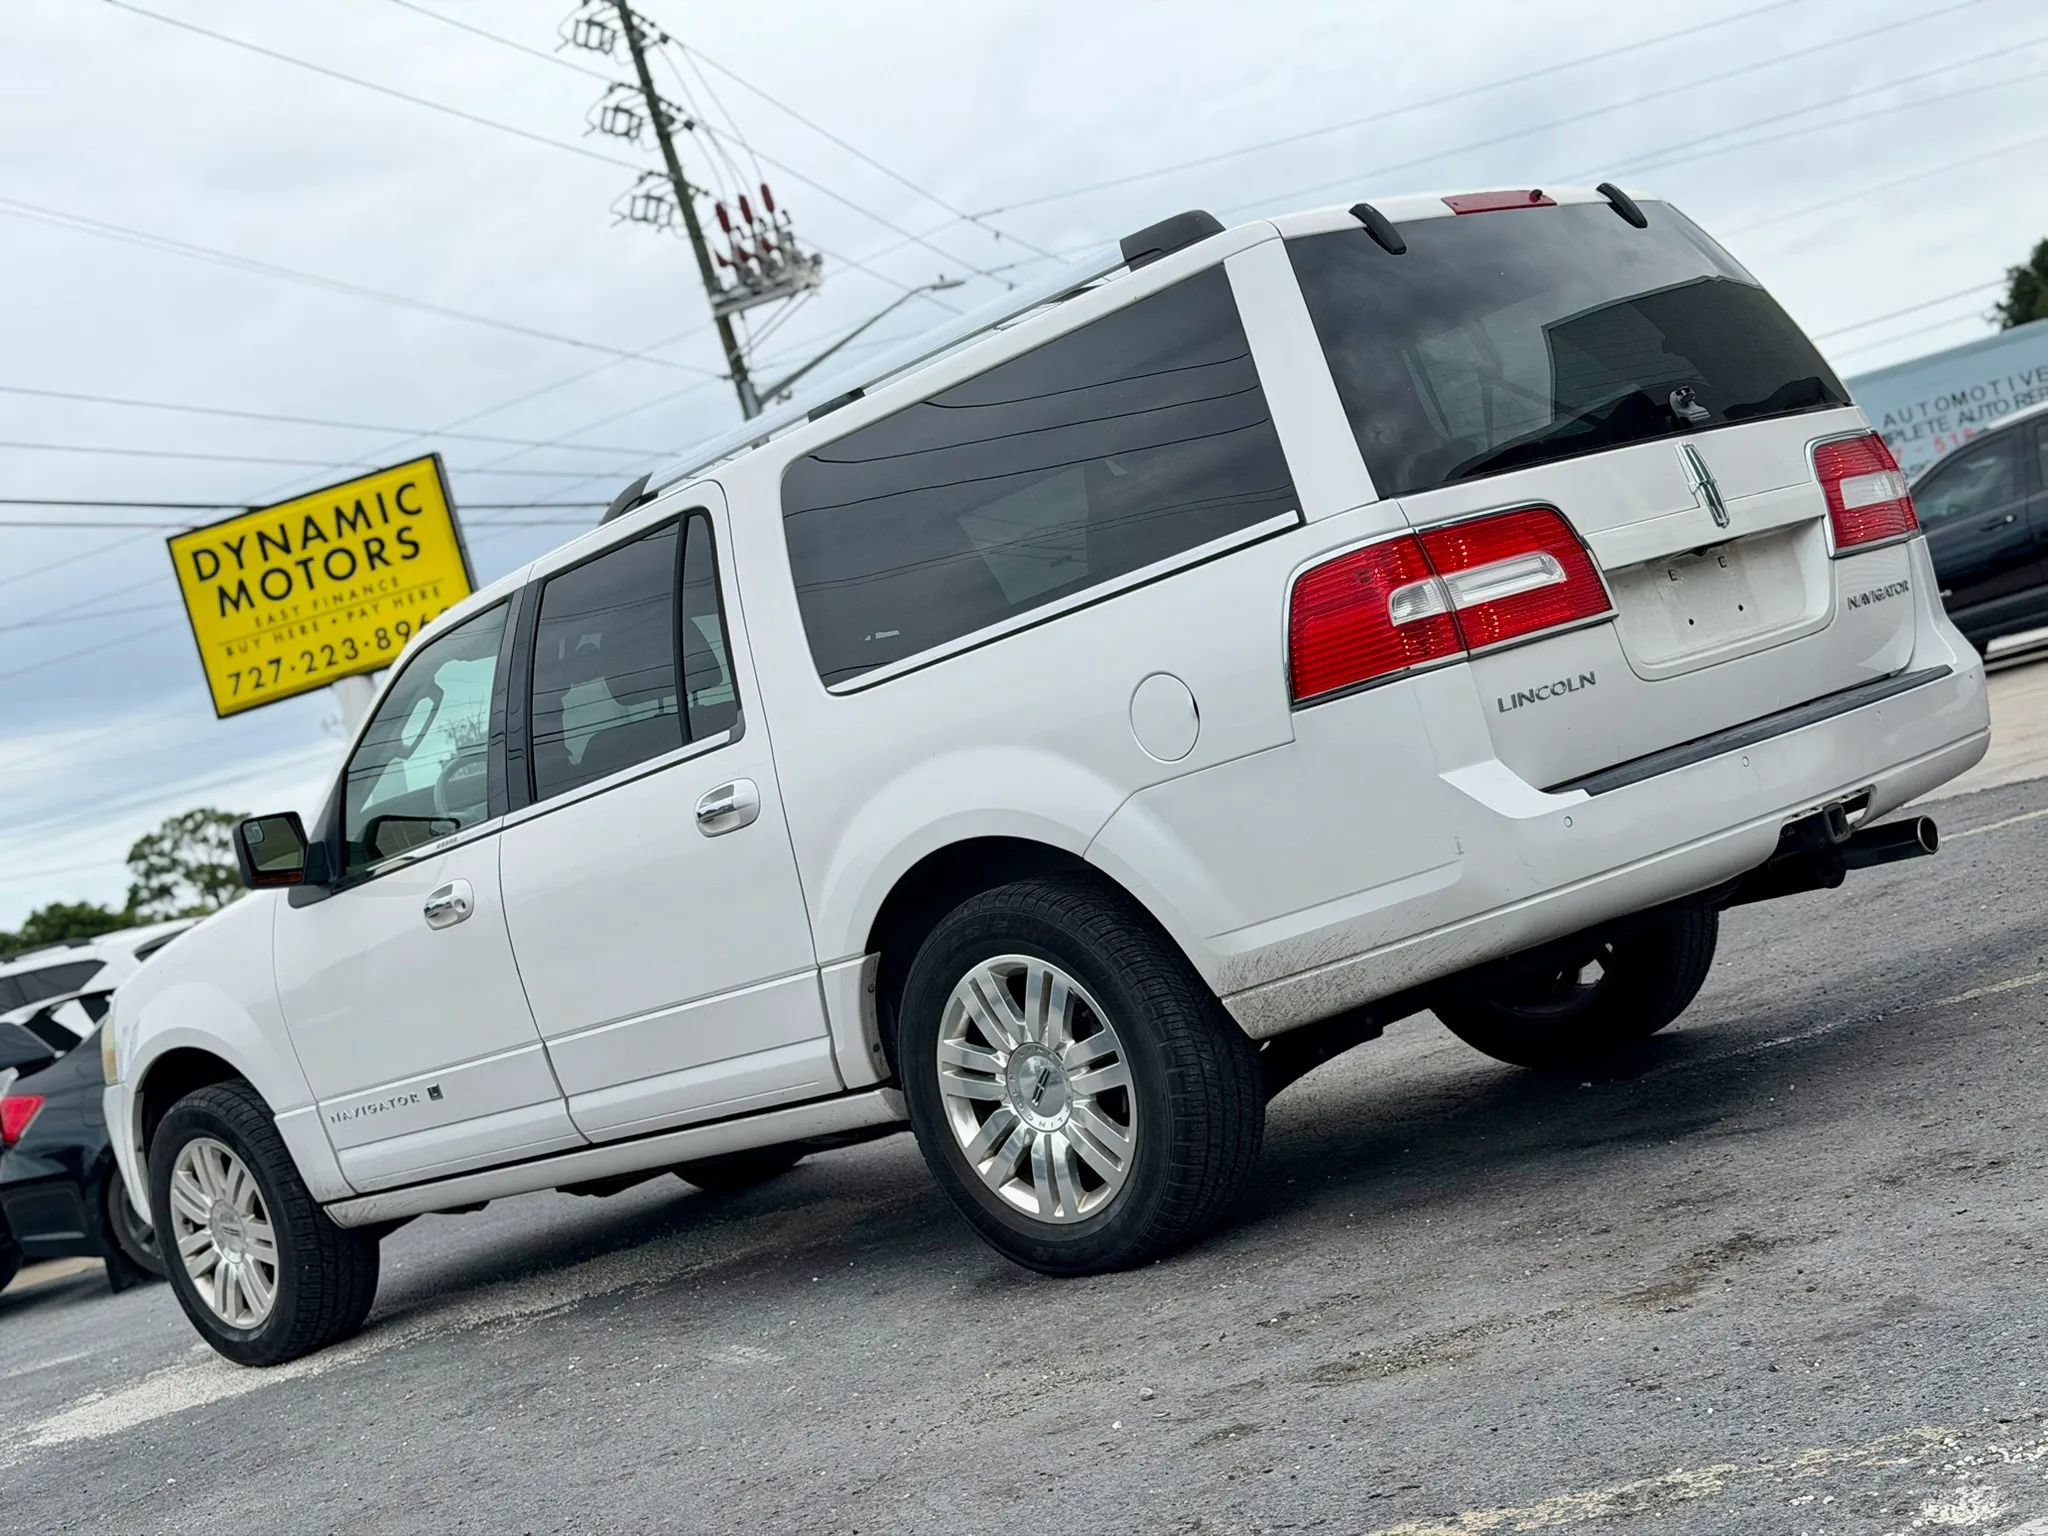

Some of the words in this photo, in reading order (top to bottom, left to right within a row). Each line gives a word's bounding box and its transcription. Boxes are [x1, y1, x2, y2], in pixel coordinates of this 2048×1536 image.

[1883, 365, 2048, 430] AUTOMOTIVE
[1958, 398, 2010, 427] AUTO
[192, 482, 423, 582] DYNAMIC
[217, 526, 421, 618] MOTORS
[1847, 580, 1910, 611] NAVIGATOR
[225, 639, 262, 657] BUY
[273, 621, 320, 644] HERE
[346, 602, 381, 622] PAY
[392, 585, 442, 609] HERE
[254, 606, 300, 629] EASY
[312, 576, 400, 610] FINANCE
[1497, 670, 1597, 713] LINCOLN
[330, 1092, 420, 1124] NAVIGATOR
